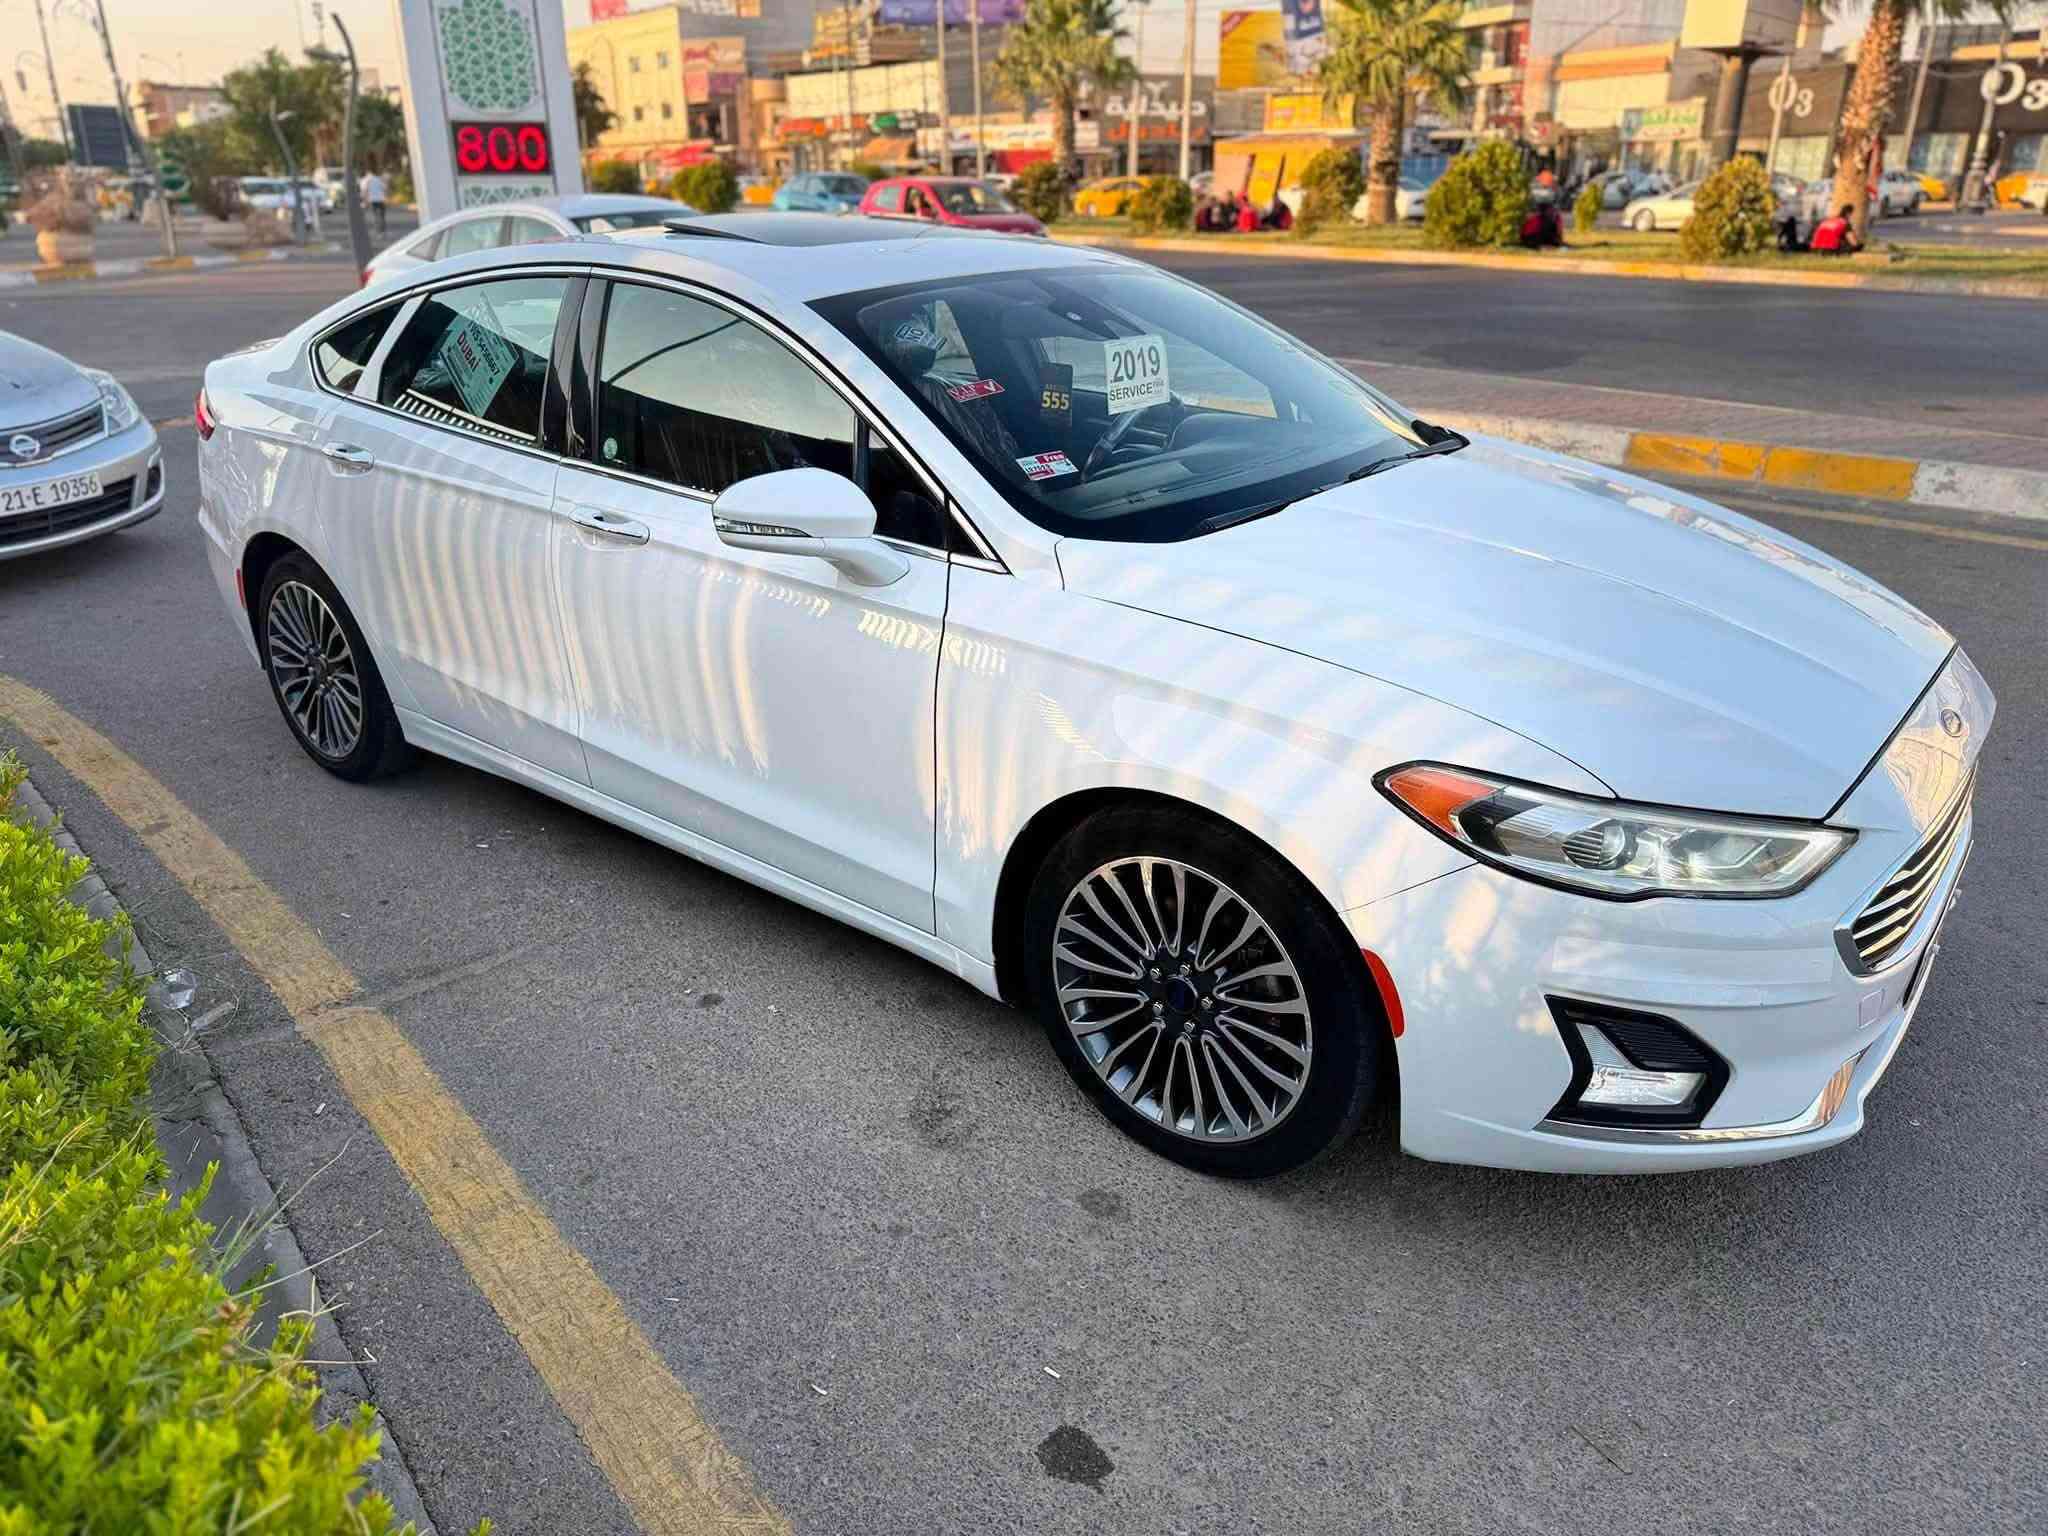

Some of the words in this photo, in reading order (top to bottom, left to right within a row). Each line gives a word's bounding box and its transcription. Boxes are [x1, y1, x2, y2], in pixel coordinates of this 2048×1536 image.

[457, 125, 547, 173] 800
[1110, 345, 1161, 383] 2019
[1041, 391, 1070, 410] 555
[1109, 382, 1153, 401] SERVICE
[50, 473, 97, 502] 19356
